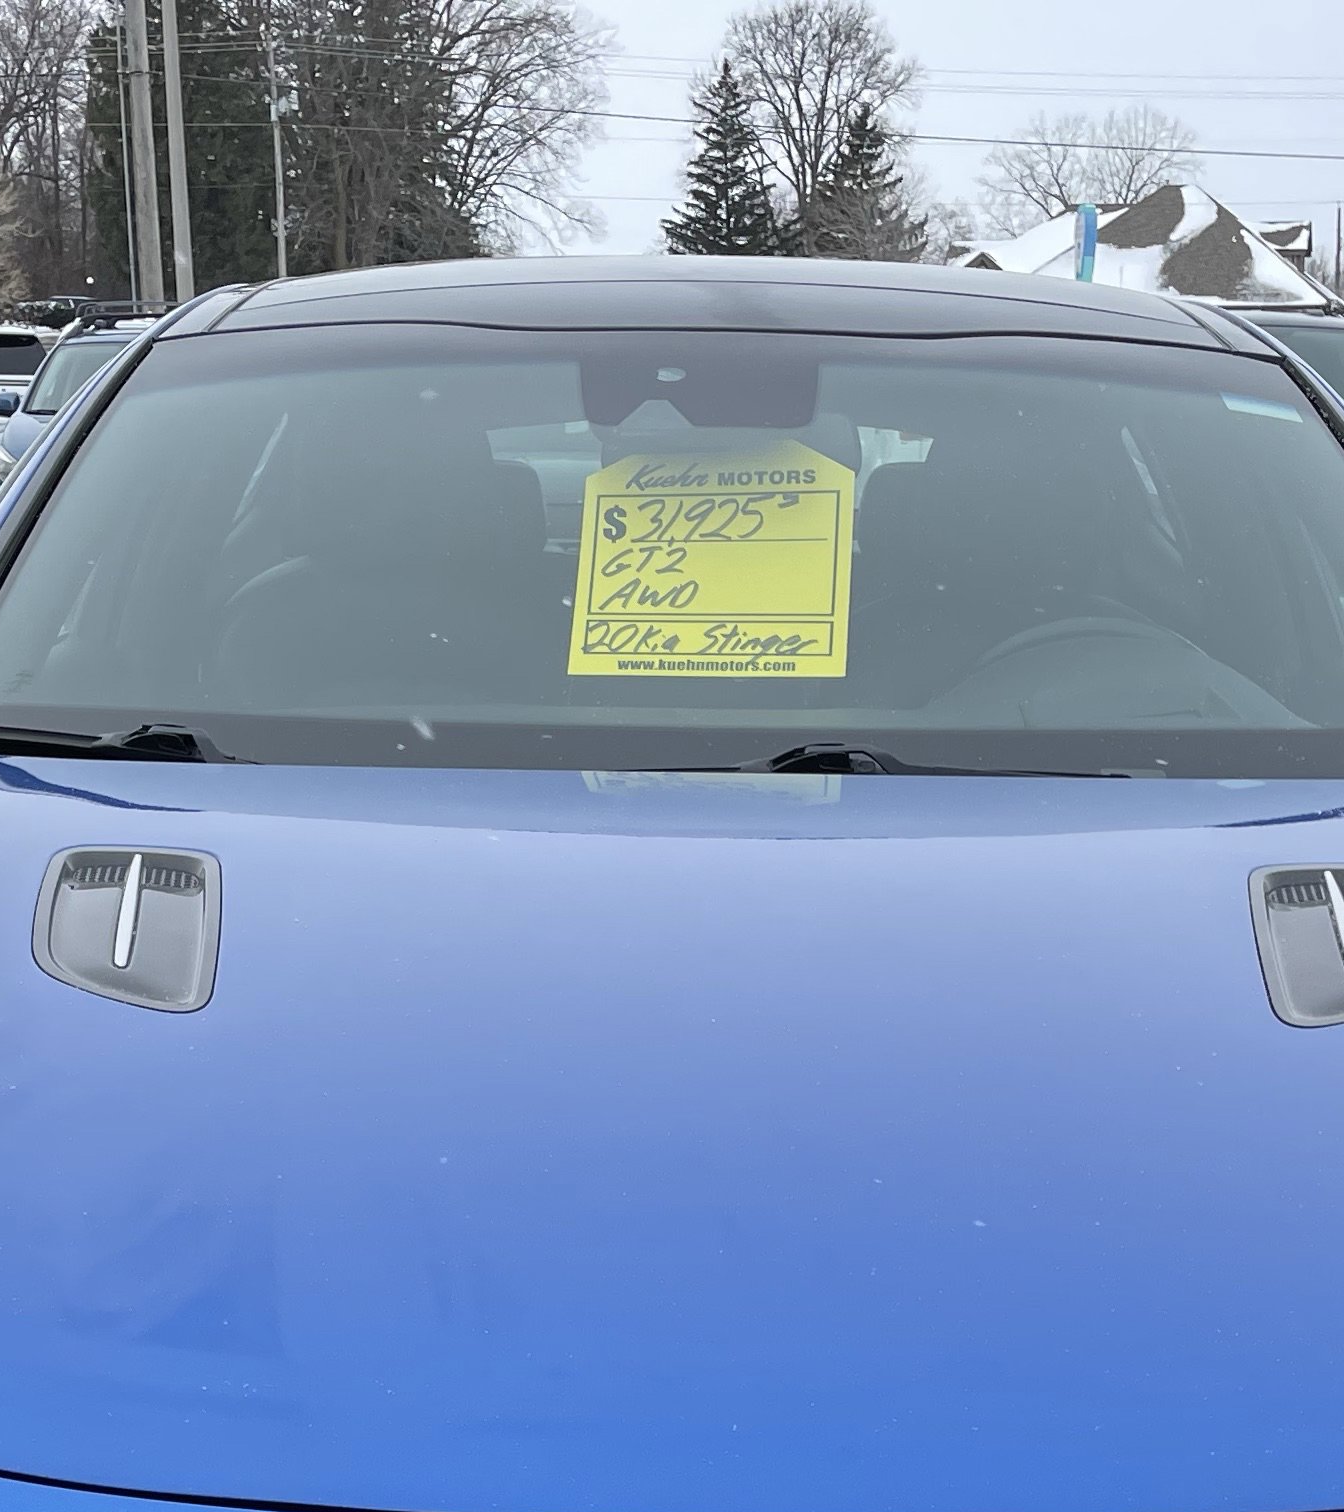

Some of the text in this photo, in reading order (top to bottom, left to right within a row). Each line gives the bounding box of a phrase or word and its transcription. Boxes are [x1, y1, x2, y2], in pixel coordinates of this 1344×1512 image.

[625, 463, 817, 491] Kuehn MOTORS
[601, 546, 688, 578] GT2
[697, 623, 818, 664] Stinger
[617, 658, 796, 673] www.kuehnmotors.com
